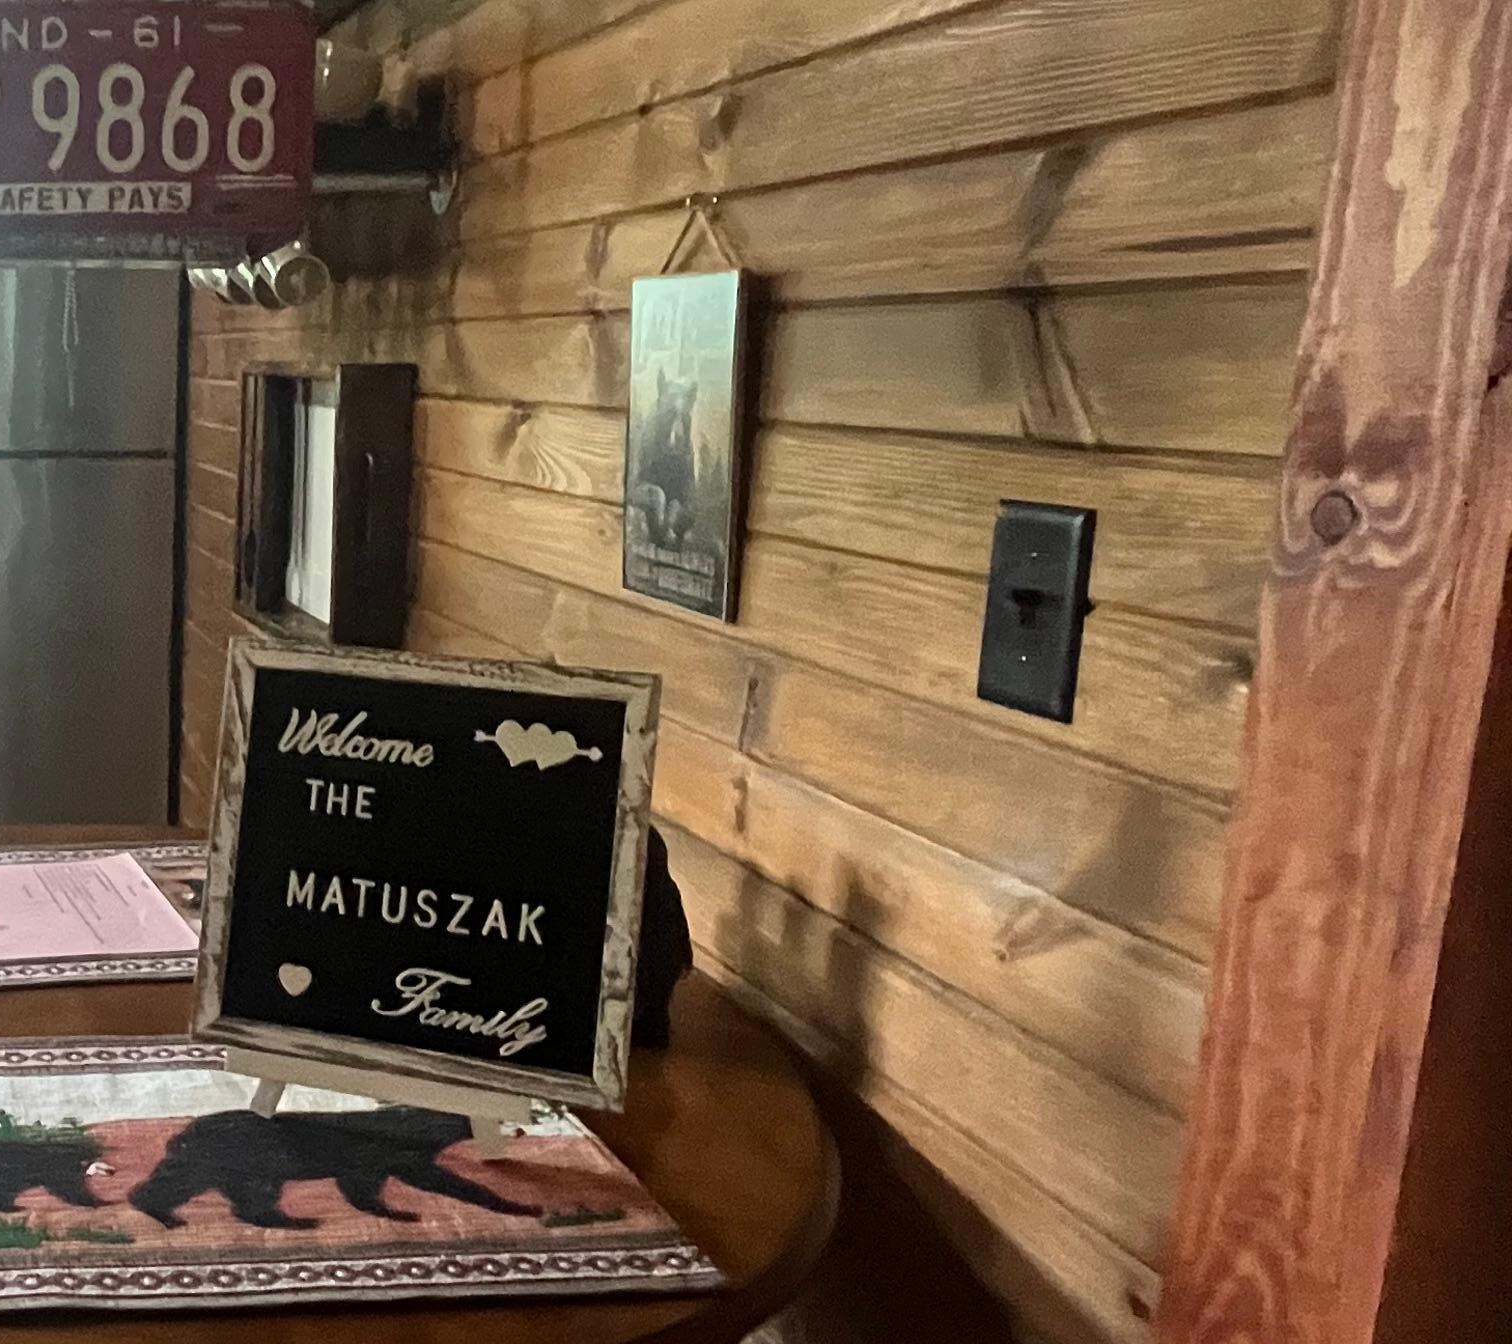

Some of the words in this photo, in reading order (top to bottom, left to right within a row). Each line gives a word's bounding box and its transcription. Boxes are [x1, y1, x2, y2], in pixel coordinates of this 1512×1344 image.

[132, 14, 181, 50] 61
[31, 62, 277, 174] 9868
[108, 187, 185, 212] PAYS
[278, 707, 435, 768] Welcome
[305, 778, 377, 820] THE
[286, 870, 546, 946] MATUSZAK
[371, 967, 548, 1057] Family
